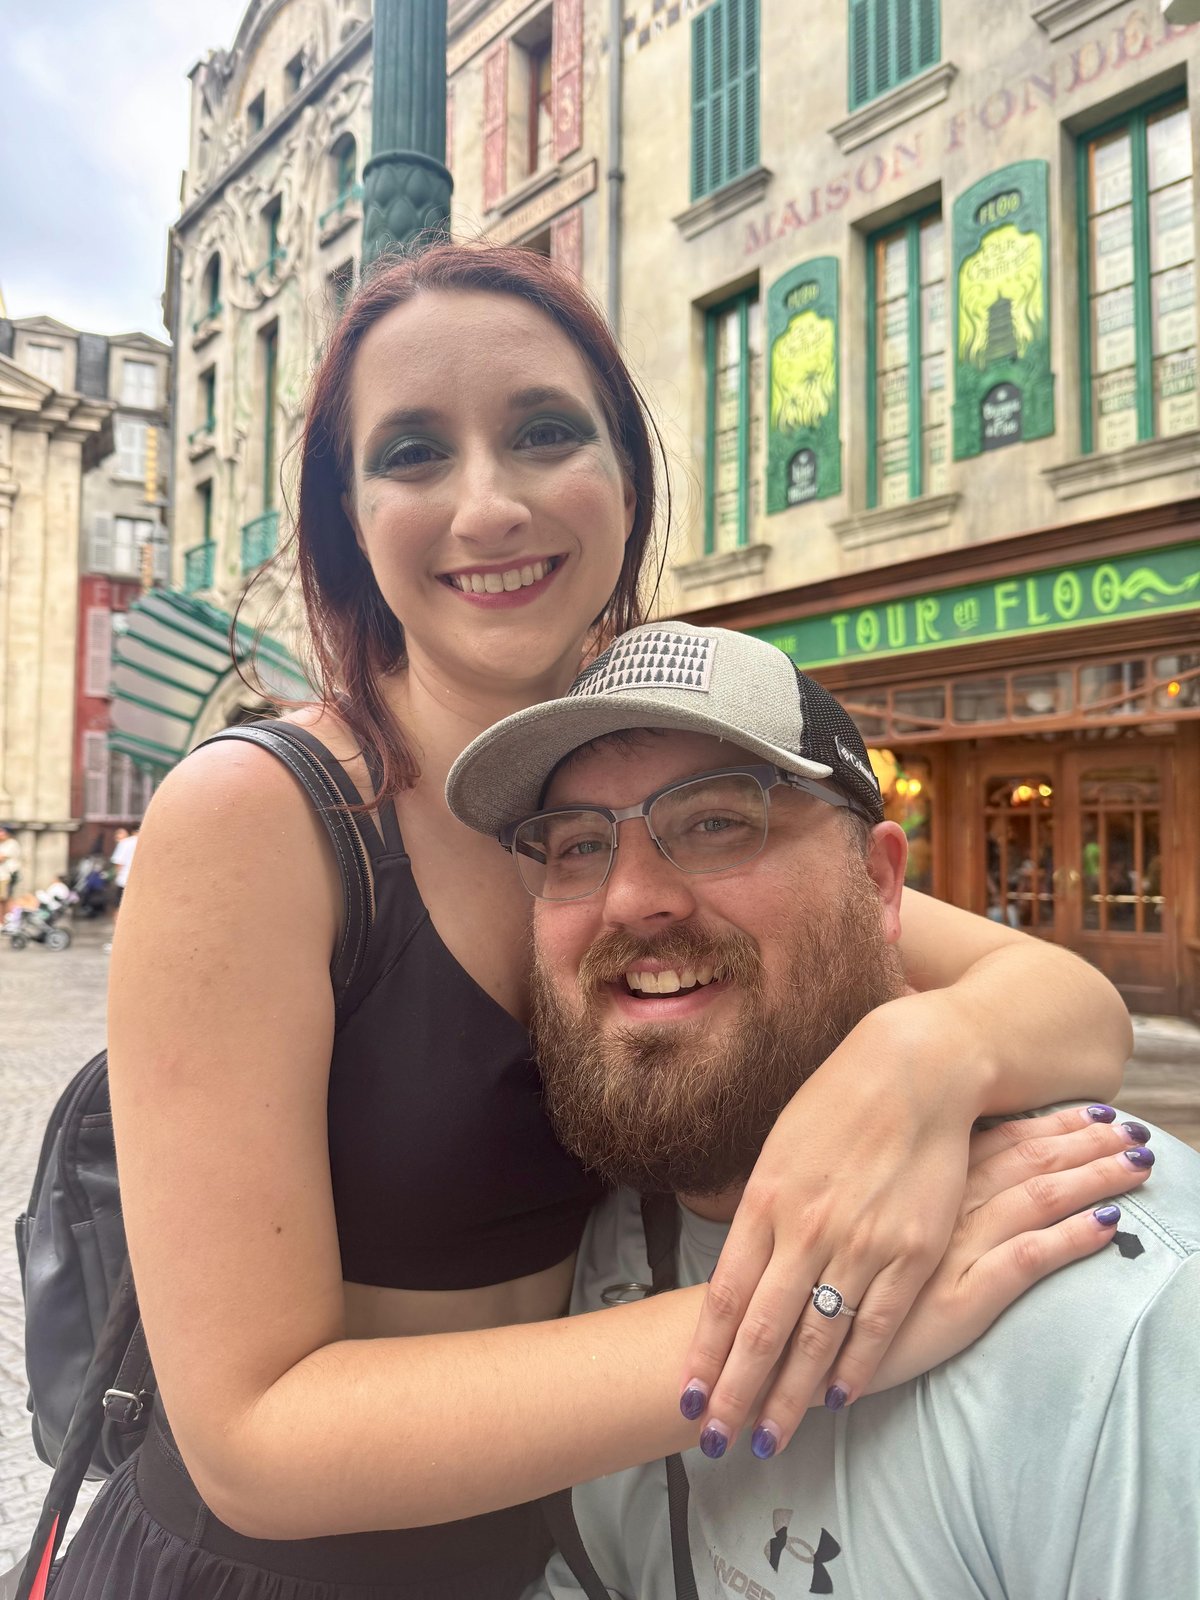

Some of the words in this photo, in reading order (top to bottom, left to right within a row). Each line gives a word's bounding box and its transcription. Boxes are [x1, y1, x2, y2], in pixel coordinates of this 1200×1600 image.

[744, 132, 924, 254] MAISON
[831, 597, 942, 657] TOUR
[994, 563, 1121, 631] FLOO
[713, 1553, 776, 1600] NDER
